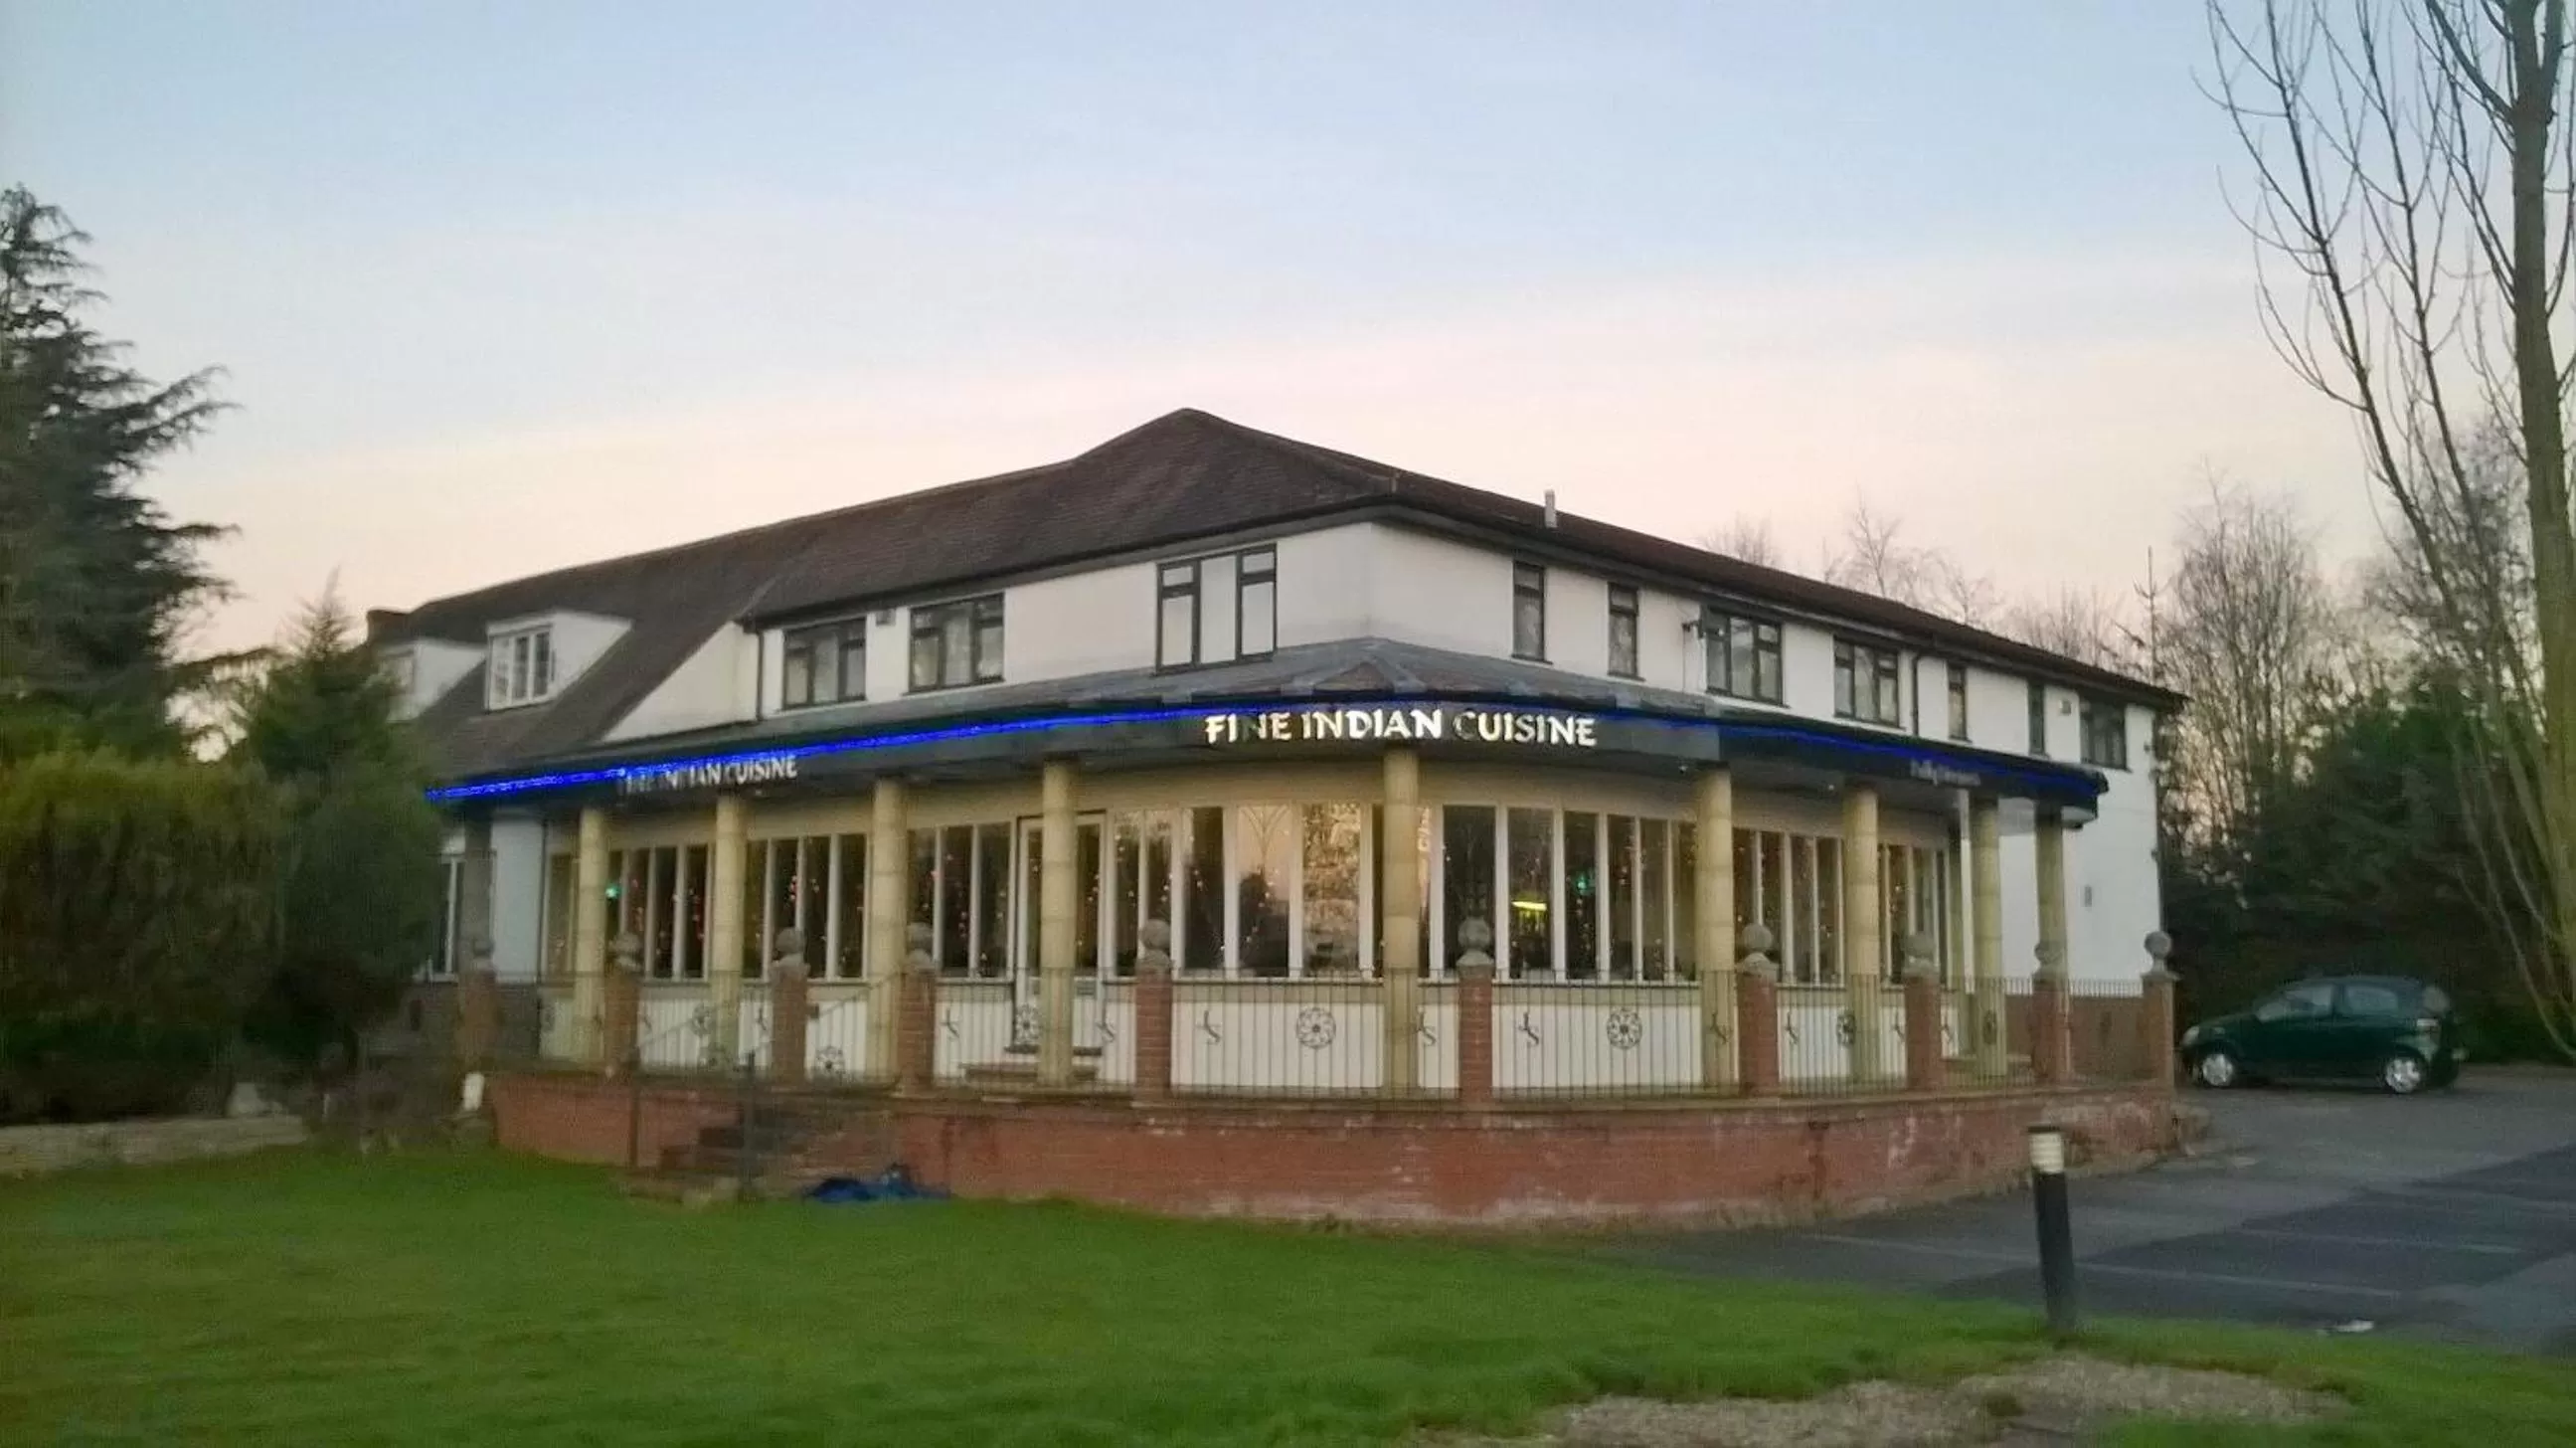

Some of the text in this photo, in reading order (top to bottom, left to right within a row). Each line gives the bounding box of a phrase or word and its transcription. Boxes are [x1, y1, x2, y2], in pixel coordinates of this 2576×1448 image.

[1204, 709, 1598, 747] FINE INDIAN CUISINE
